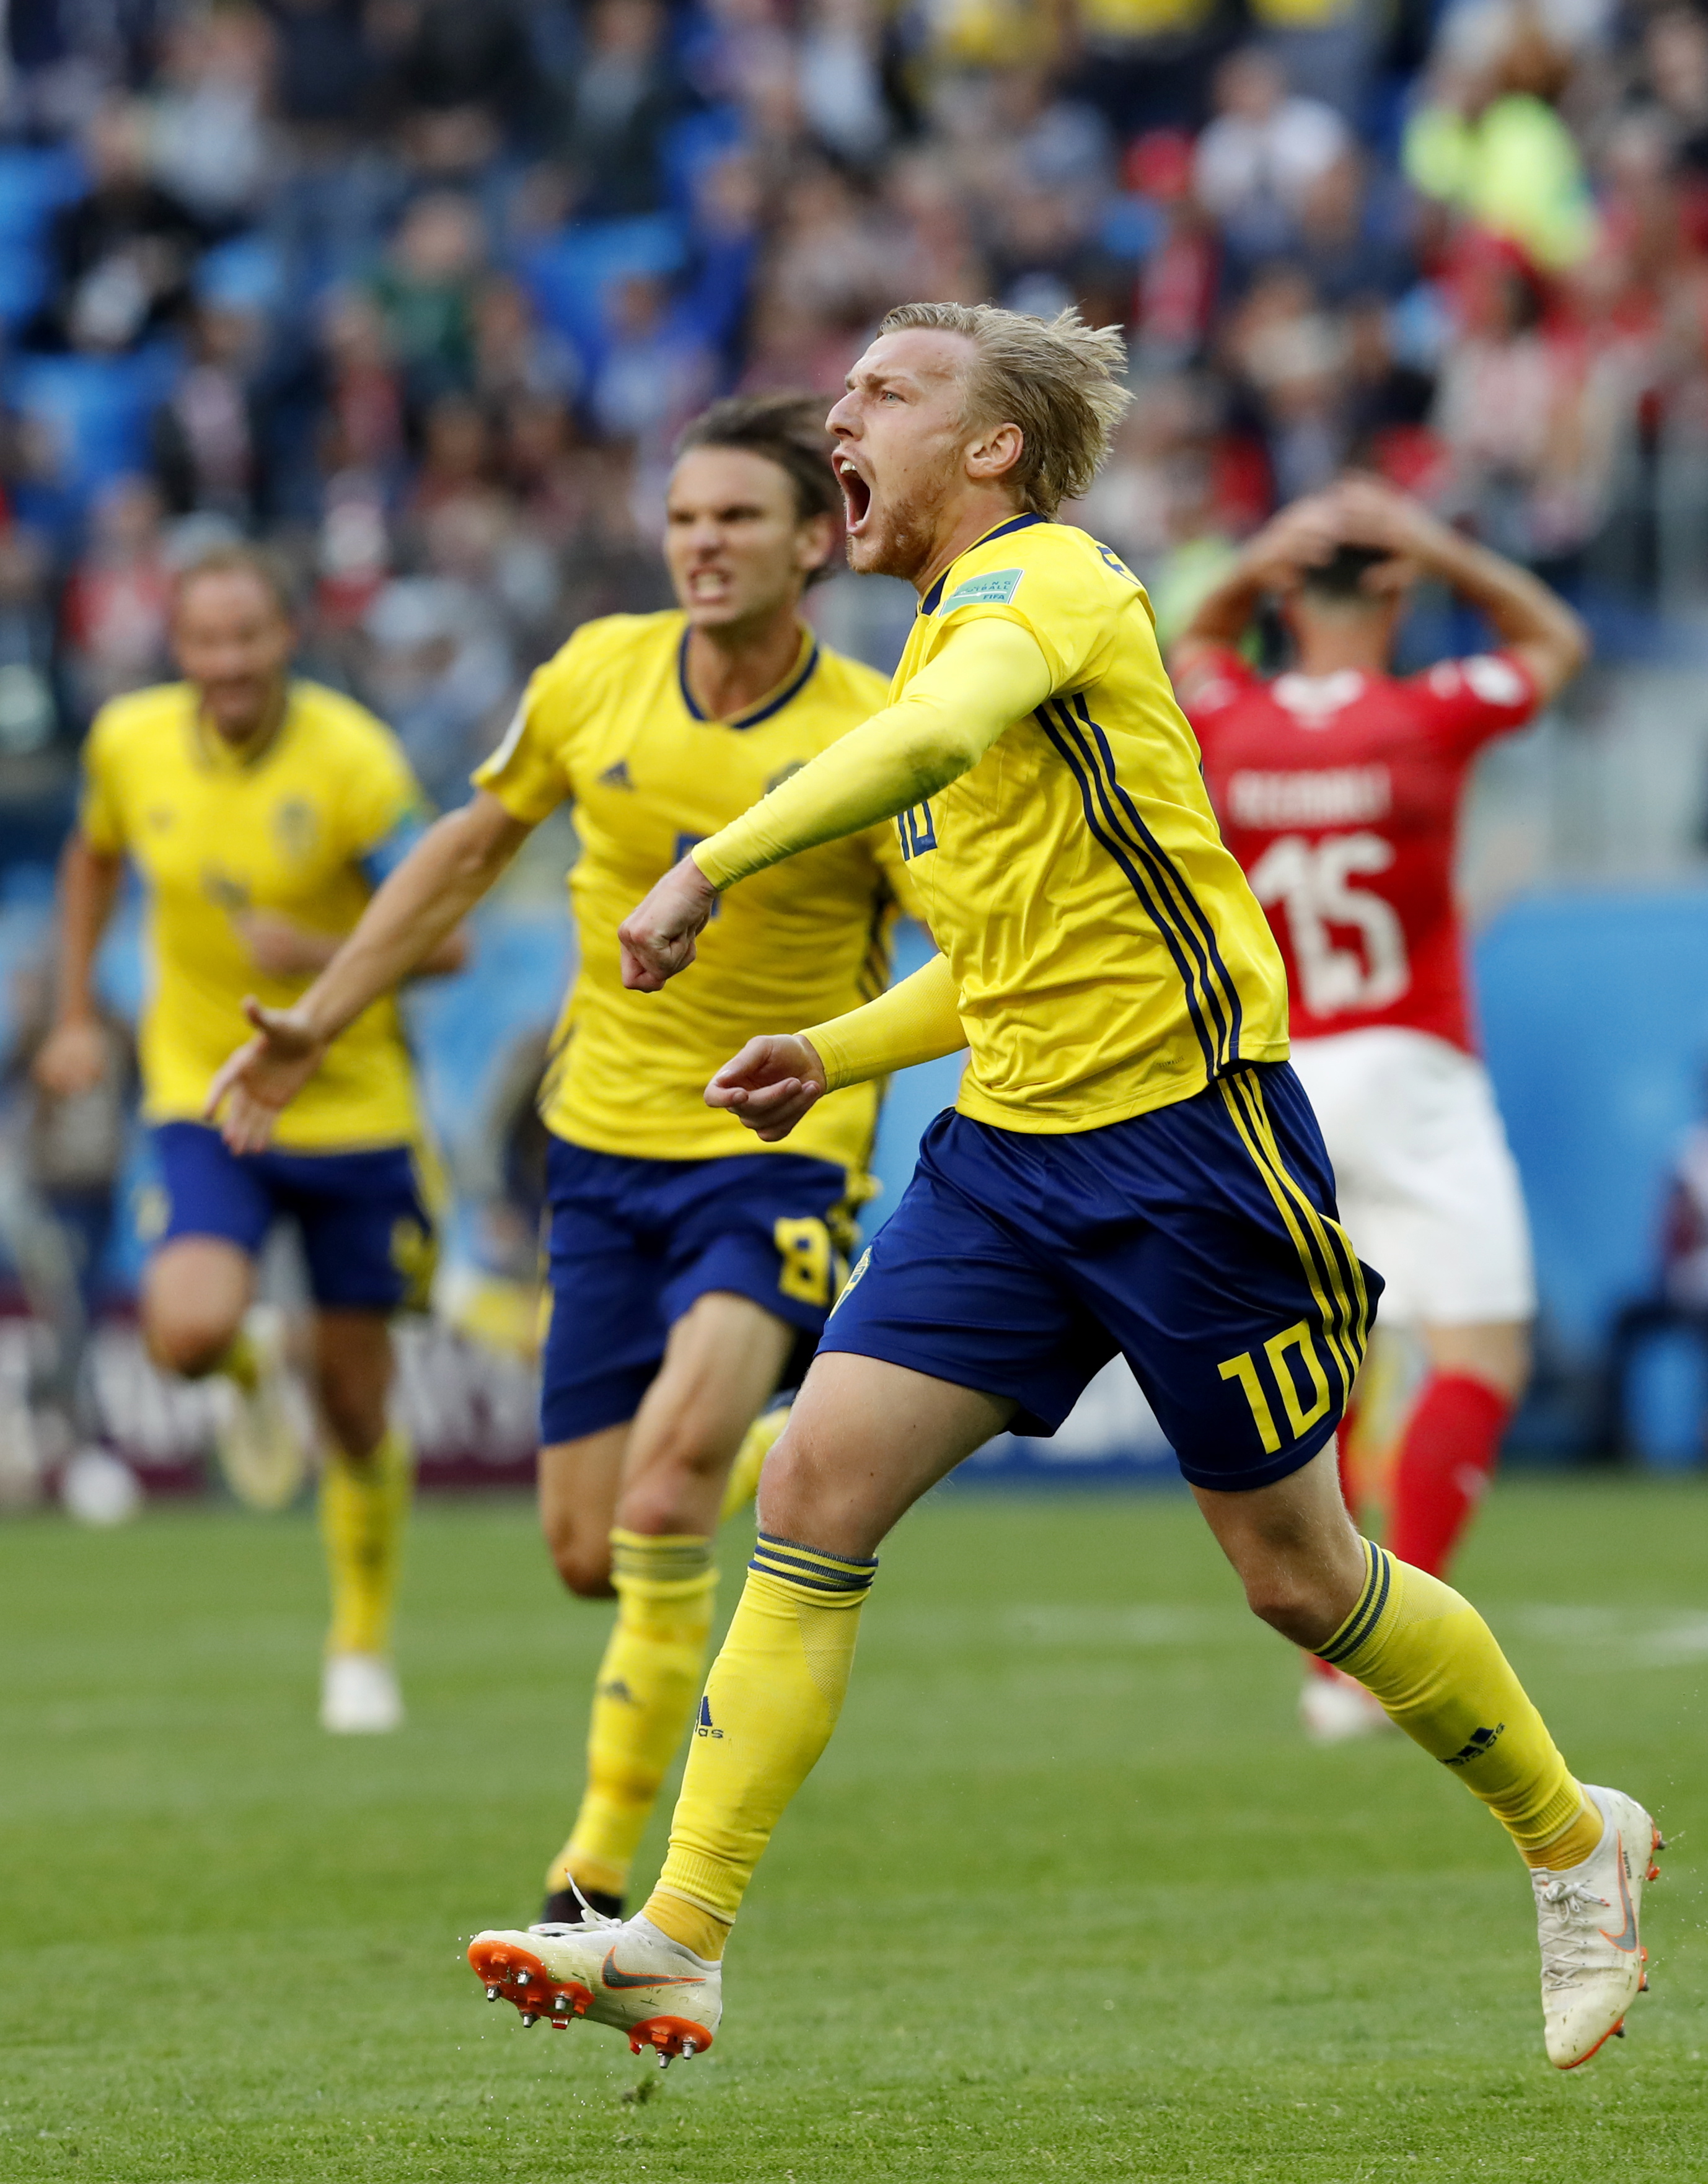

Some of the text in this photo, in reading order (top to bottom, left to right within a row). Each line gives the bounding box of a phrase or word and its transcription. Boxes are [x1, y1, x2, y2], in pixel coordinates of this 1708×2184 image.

[1251, 834, 1409, 1019] 15
[774, 1217, 832, 1307] 8
[1217, 1318, 1331, 1454] 10
